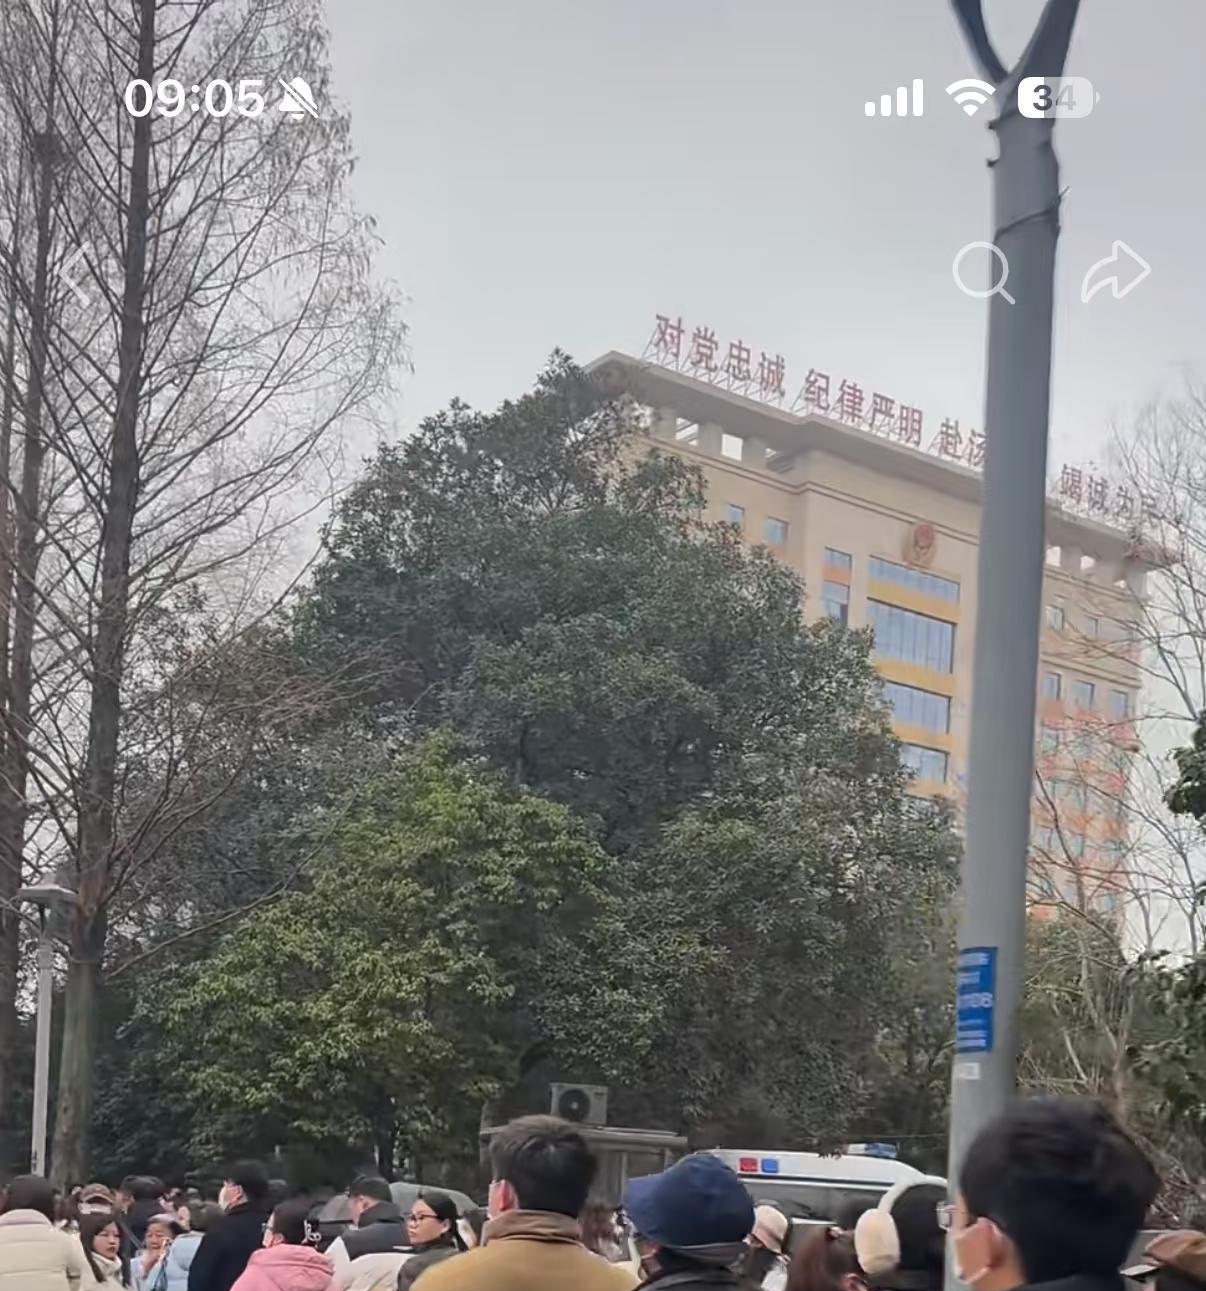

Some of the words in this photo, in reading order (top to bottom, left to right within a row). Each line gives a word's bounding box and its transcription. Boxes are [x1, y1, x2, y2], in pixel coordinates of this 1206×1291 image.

[654, 314, 786, 398] 对党忠诚
[803, 367, 923, 448] 纪律严明
